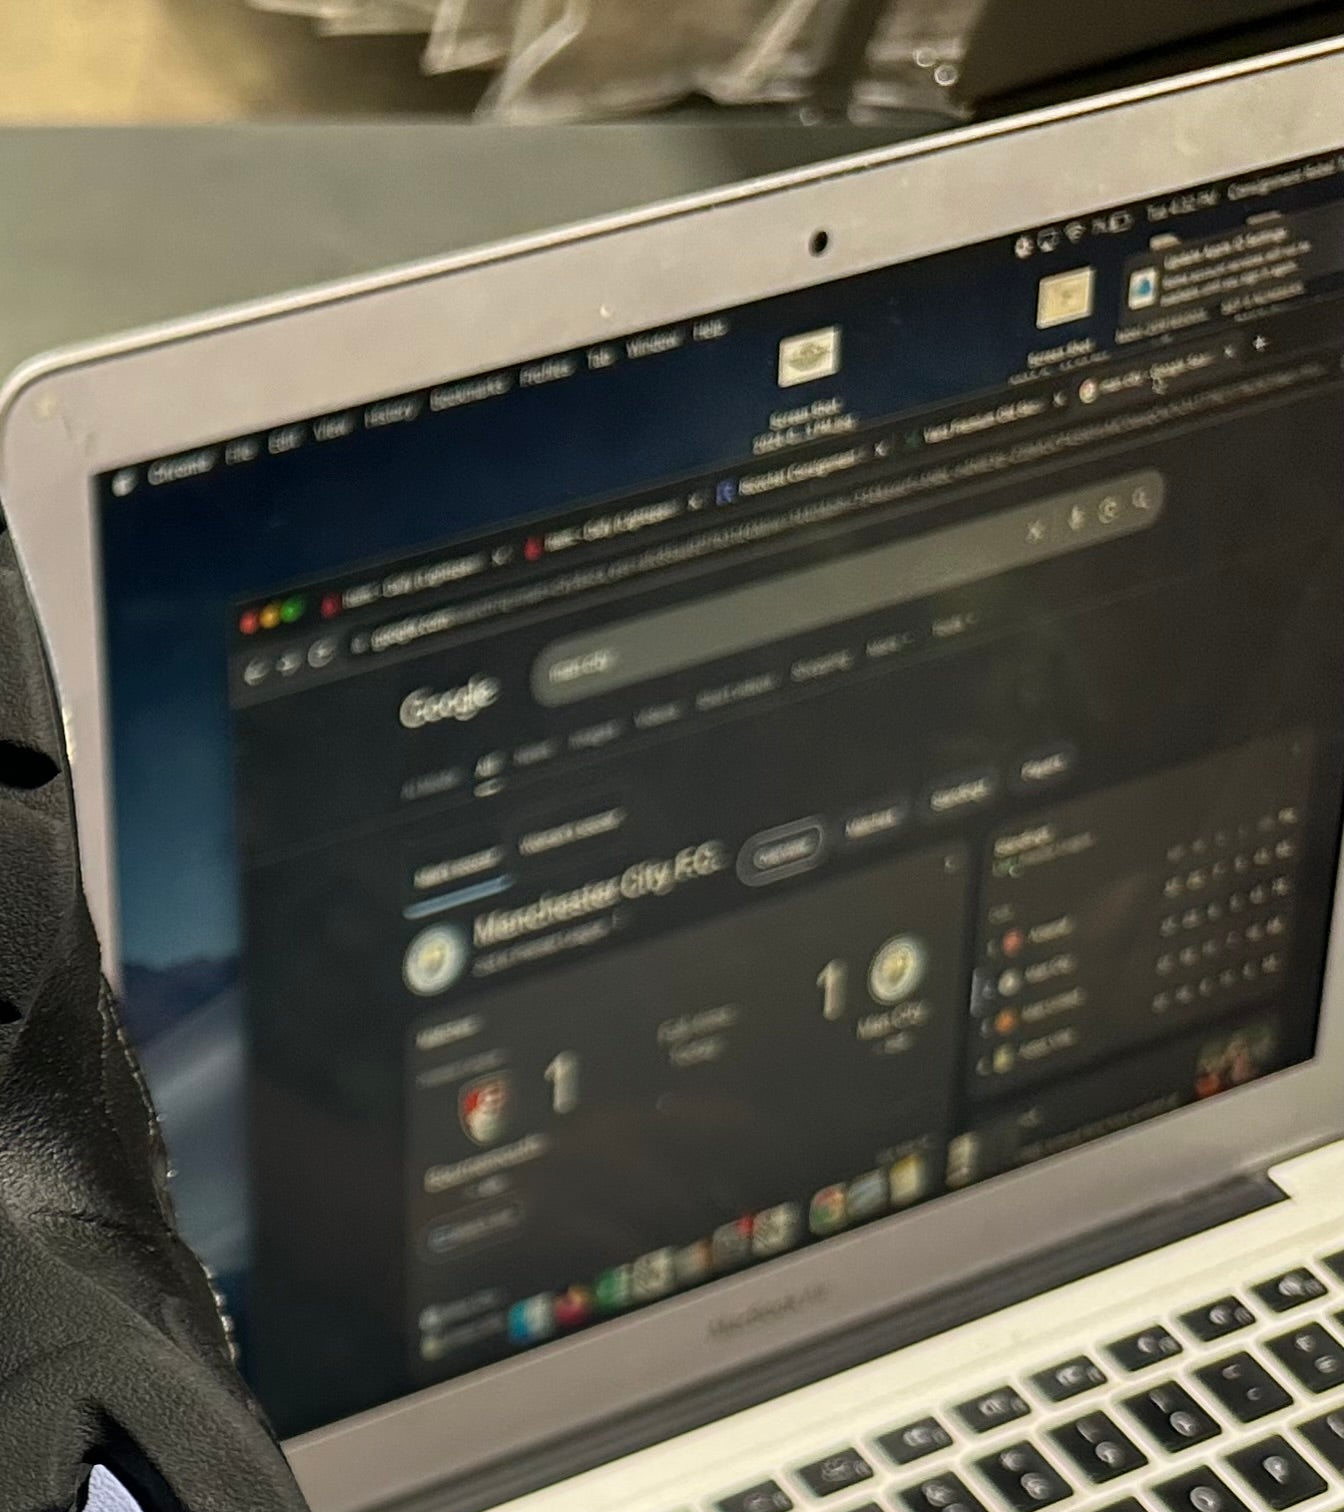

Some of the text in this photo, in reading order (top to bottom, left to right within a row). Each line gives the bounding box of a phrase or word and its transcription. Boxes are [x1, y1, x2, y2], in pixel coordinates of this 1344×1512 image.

[400, 672, 502, 728] Google
[473, 873, 620, 948] Manchester
[620, 857, 676, 899] City
[816, 958, 847, 1021] 1
[544, 1050, 580, 1114] 1
[1263, 1455, 1289, 1484] P
